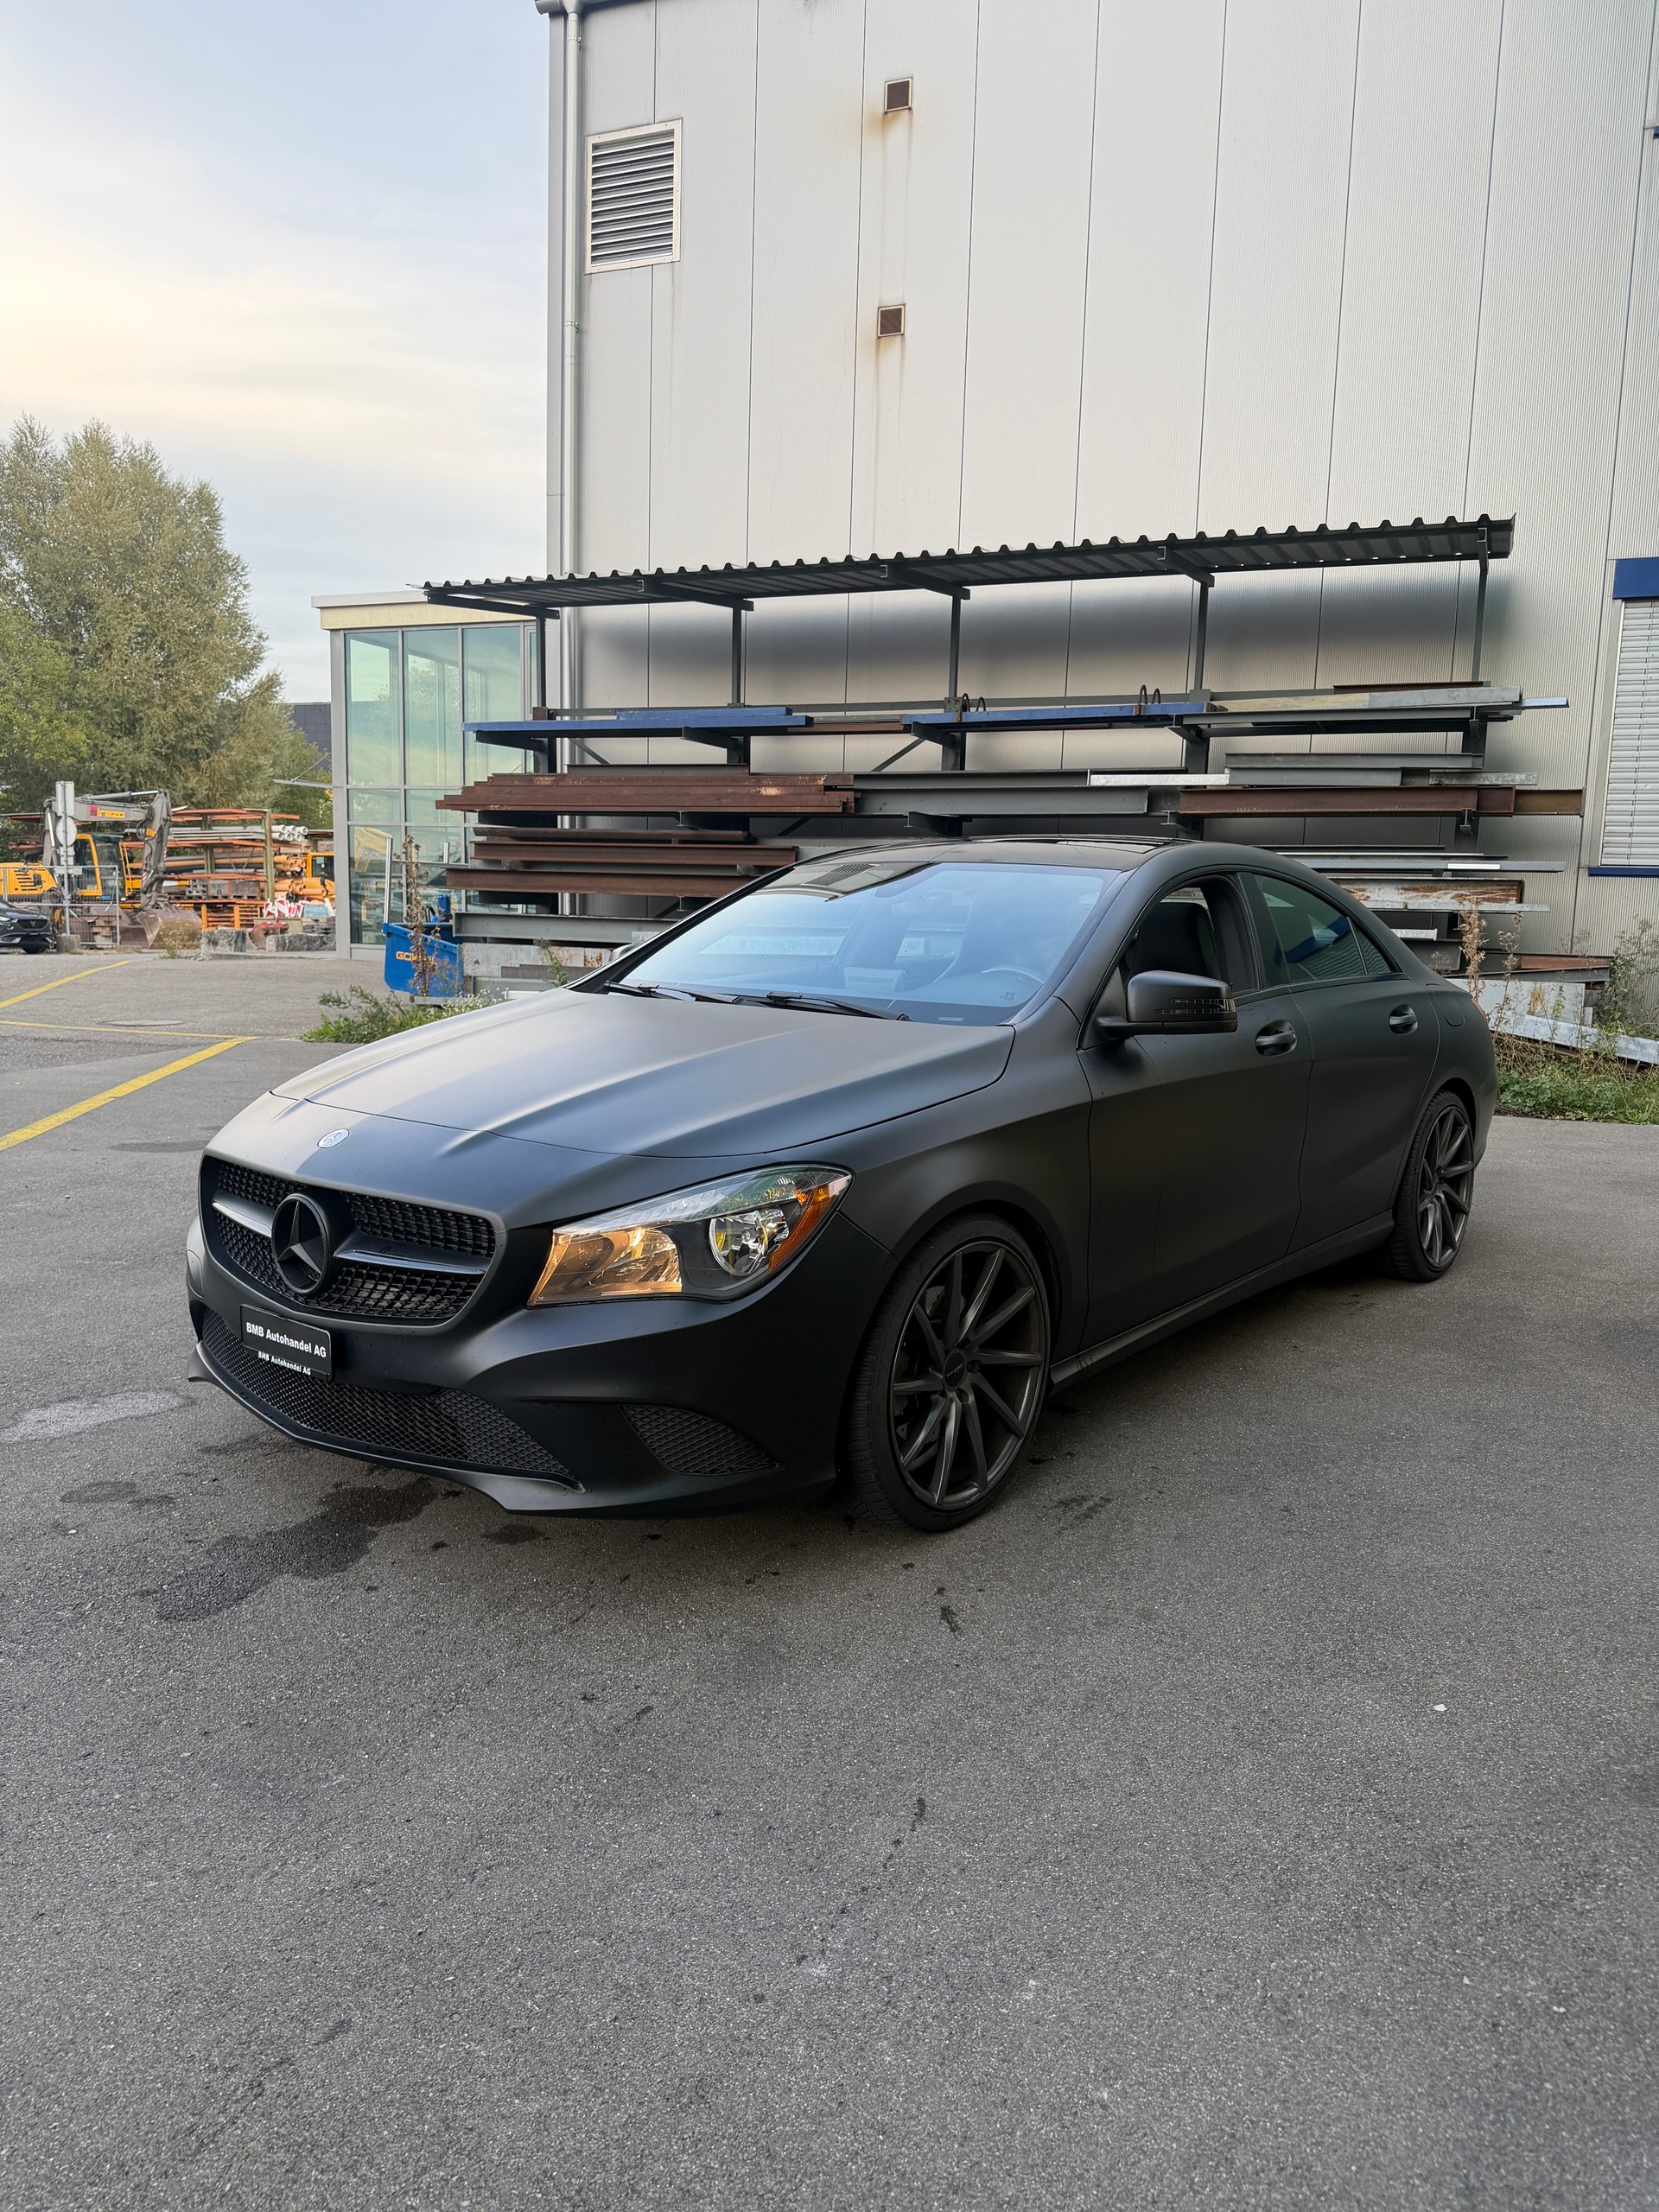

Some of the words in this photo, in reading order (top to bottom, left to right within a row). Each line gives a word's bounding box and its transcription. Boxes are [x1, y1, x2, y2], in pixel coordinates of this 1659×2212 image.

[245, 1321, 264, 1338] BMB
[265, 1329, 312, 1354] Autohandel
[314, 1344, 327, 1358] AG
[270, 1356, 302, 1373] Autohandel
[302, 1366, 311, 1376] AG
